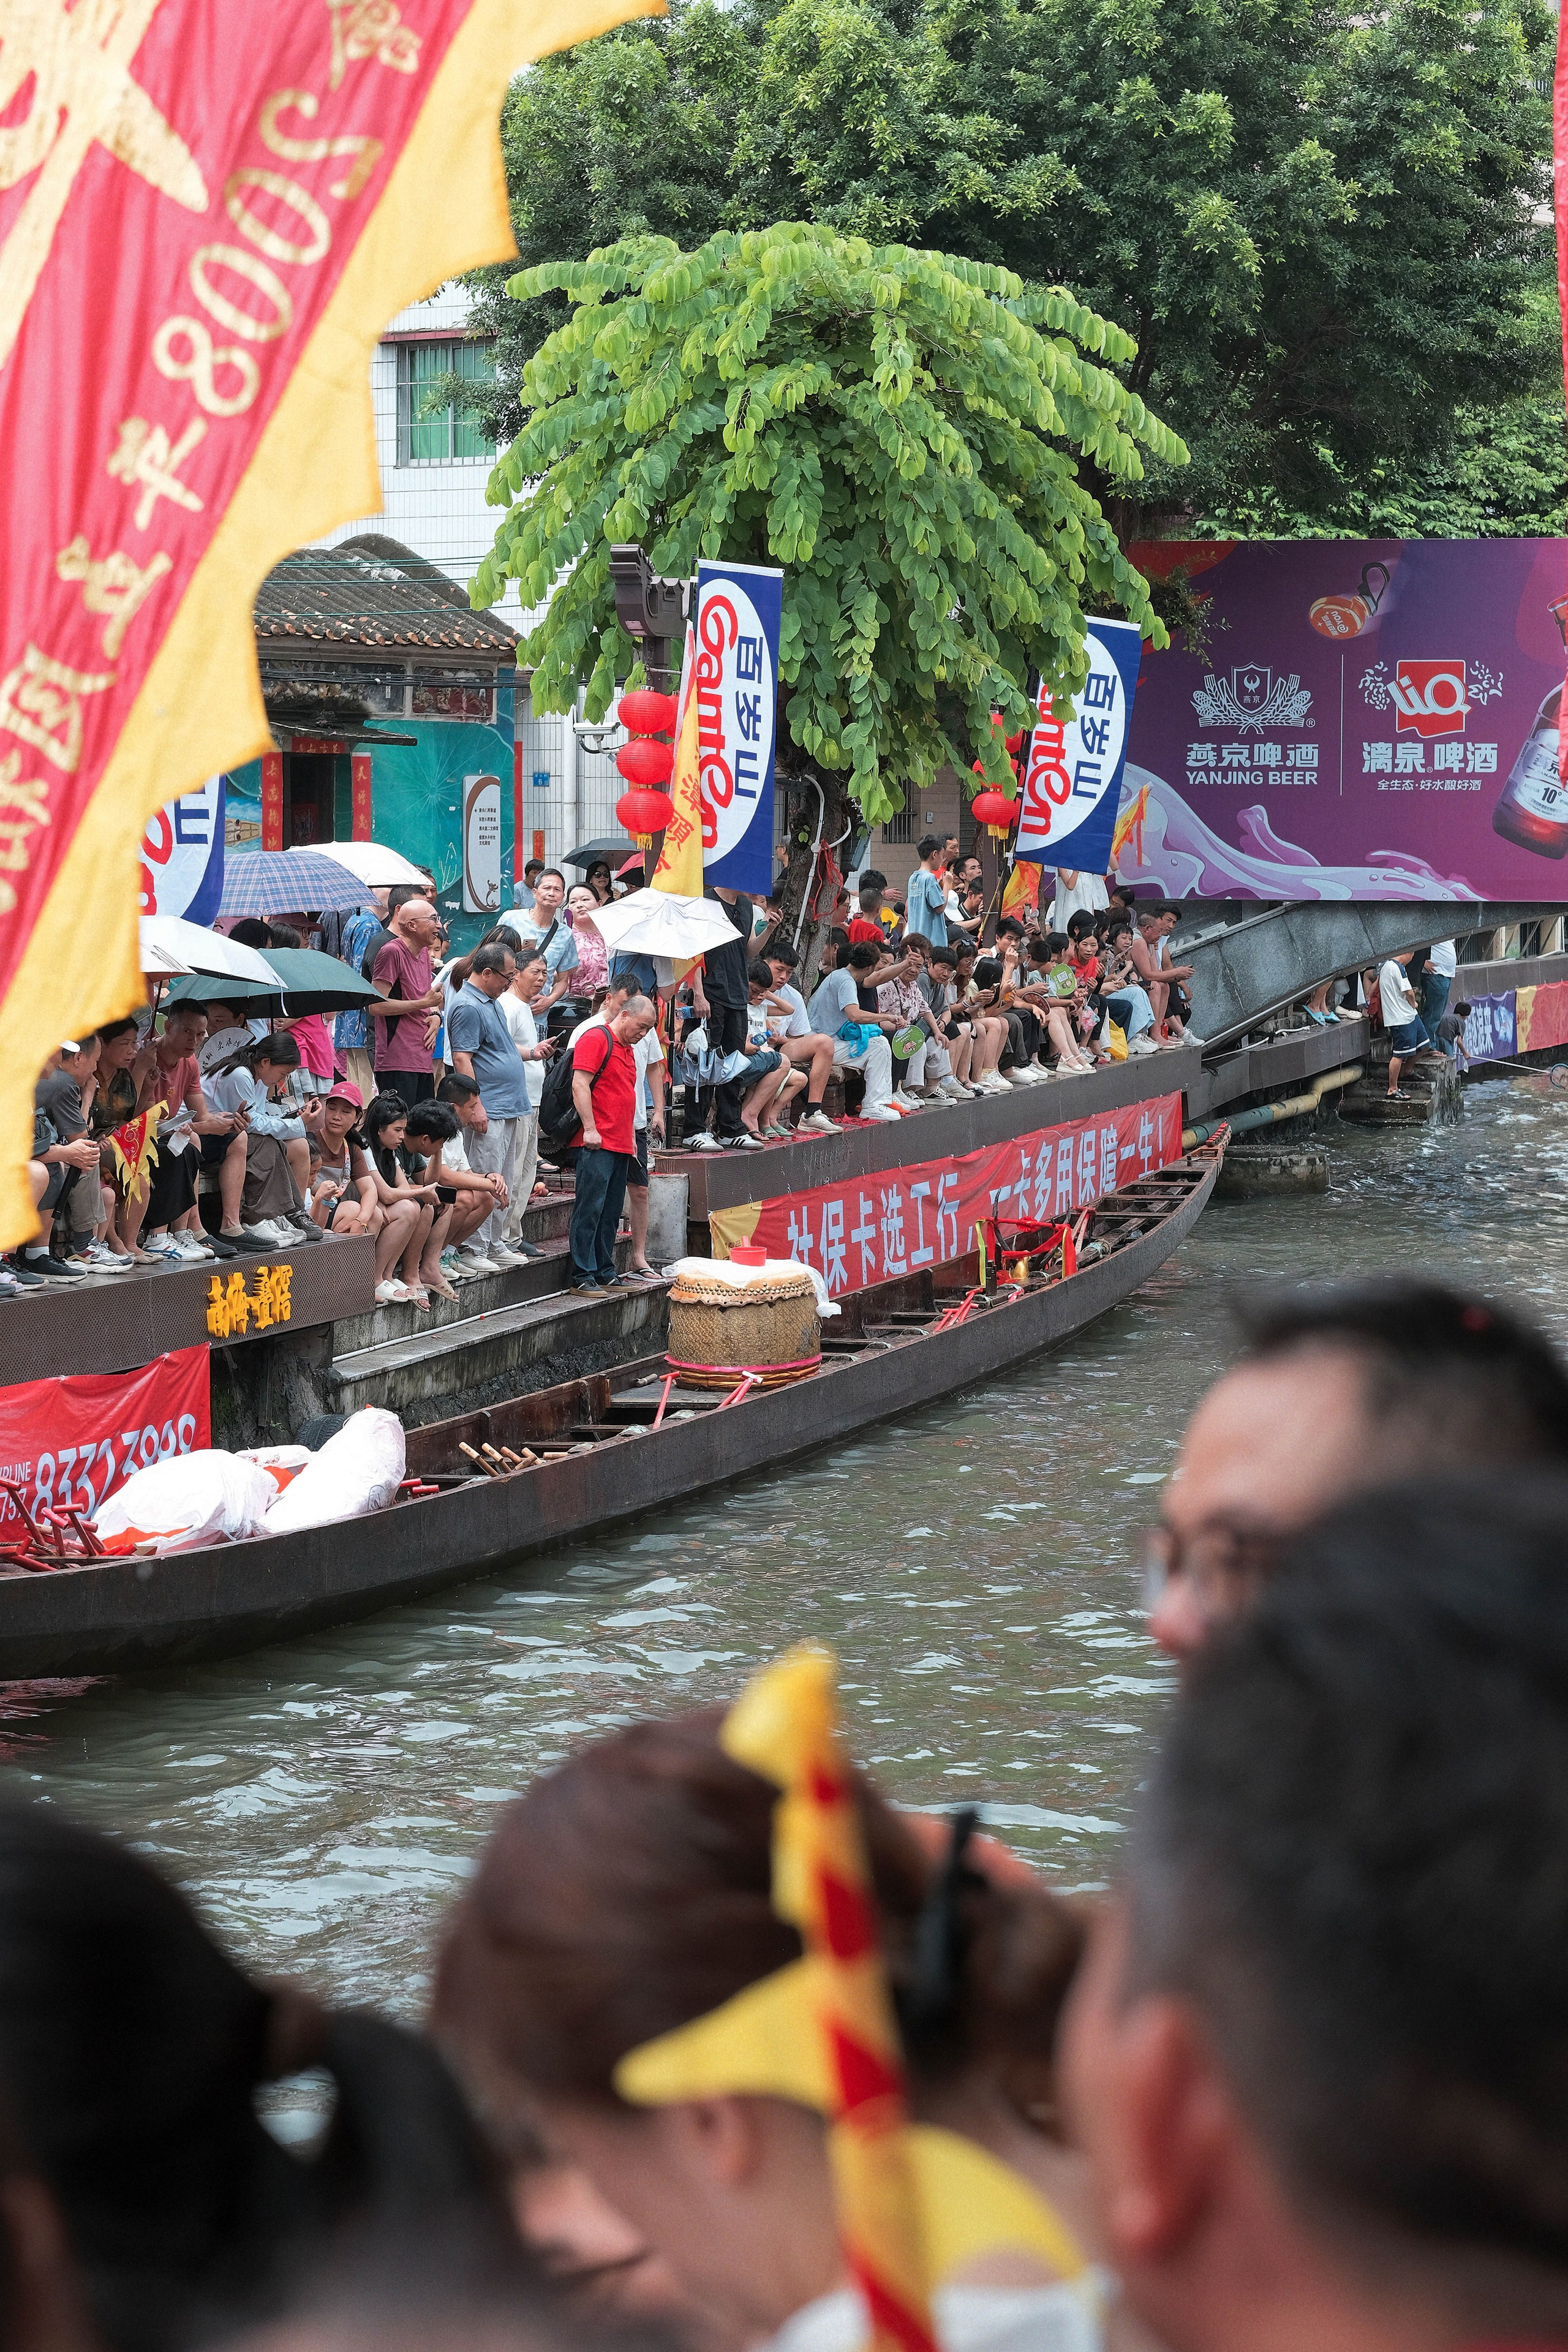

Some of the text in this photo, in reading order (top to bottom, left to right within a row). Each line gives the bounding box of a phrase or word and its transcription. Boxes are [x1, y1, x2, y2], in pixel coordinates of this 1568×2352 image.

[1243, 695, 1261, 704] 燕京
[735, 635, 764, 799] 百岁山
[1072, 673, 1117, 799] 百岁山
[1186, 742, 1319, 768] 燕京啤酒
[1186, 771, 1318, 785] YANJING BEER
[1378, 779, 1482, 791] 全生态·好水酿好酒
